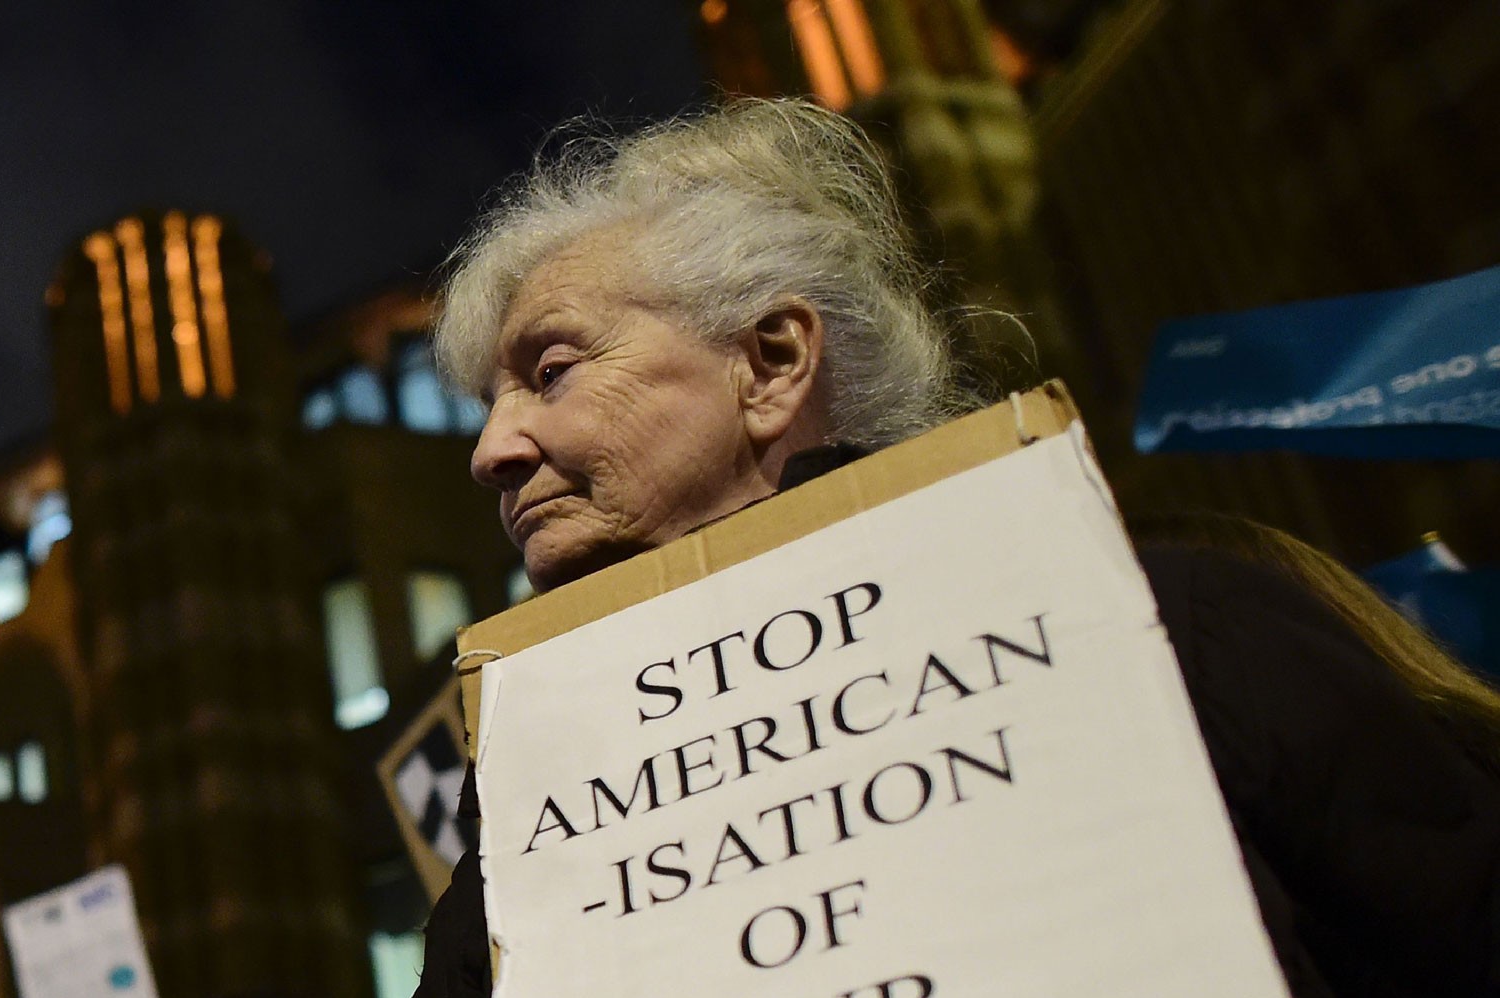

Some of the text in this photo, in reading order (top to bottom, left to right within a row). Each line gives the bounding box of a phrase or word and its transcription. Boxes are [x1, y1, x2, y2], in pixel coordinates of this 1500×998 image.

[521, 612, 1054, 854] AMERICAN
[635, 581, 883, 725] STOP
[582, 726, 1015, 918] -ISATION
[738, 879, 868, 969] OF
